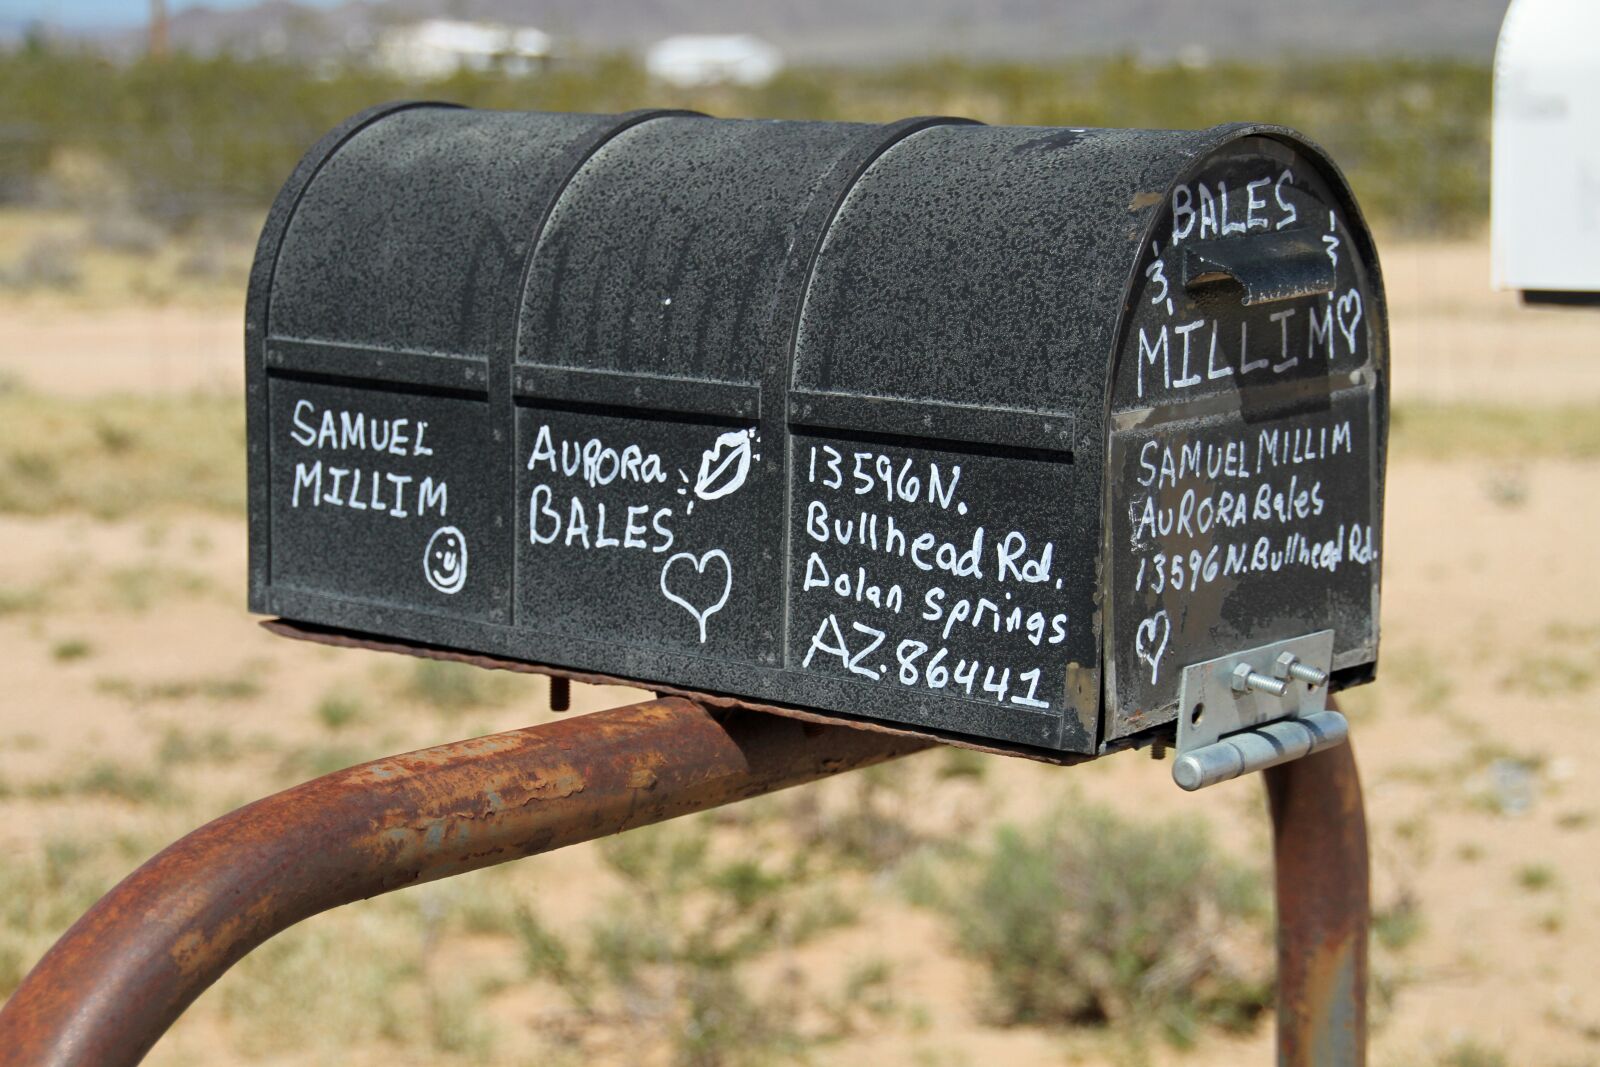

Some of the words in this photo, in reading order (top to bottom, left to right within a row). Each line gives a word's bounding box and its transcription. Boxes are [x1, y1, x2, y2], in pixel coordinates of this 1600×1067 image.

[1172, 169, 1296, 245] BALES
[1137, 305, 1335, 398] MILLIM
[291, 400, 433, 456] SAMUEL
[1137, 440, 1250, 490] SAMUEL
[1256, 421, 1352, 474] MILLIM
[292, 460, 449, 518] MILLIM
[808, 445, 920, 502] 13596
[928, 463, 968, 515] N.
[529, 485, 674, 552] BALES
[806, 500, 984, 579] Bullhead
[997, 531, 1064, 589] Rd.
[803, 552, 903, 613] Dolan
[1135, 544, 1219, 595] 13596
[1250, 524, 1344, 572] Bullhead
[1348, 523, 1378, 564] Rd.
[896, 639, 1050, 709] 86441
